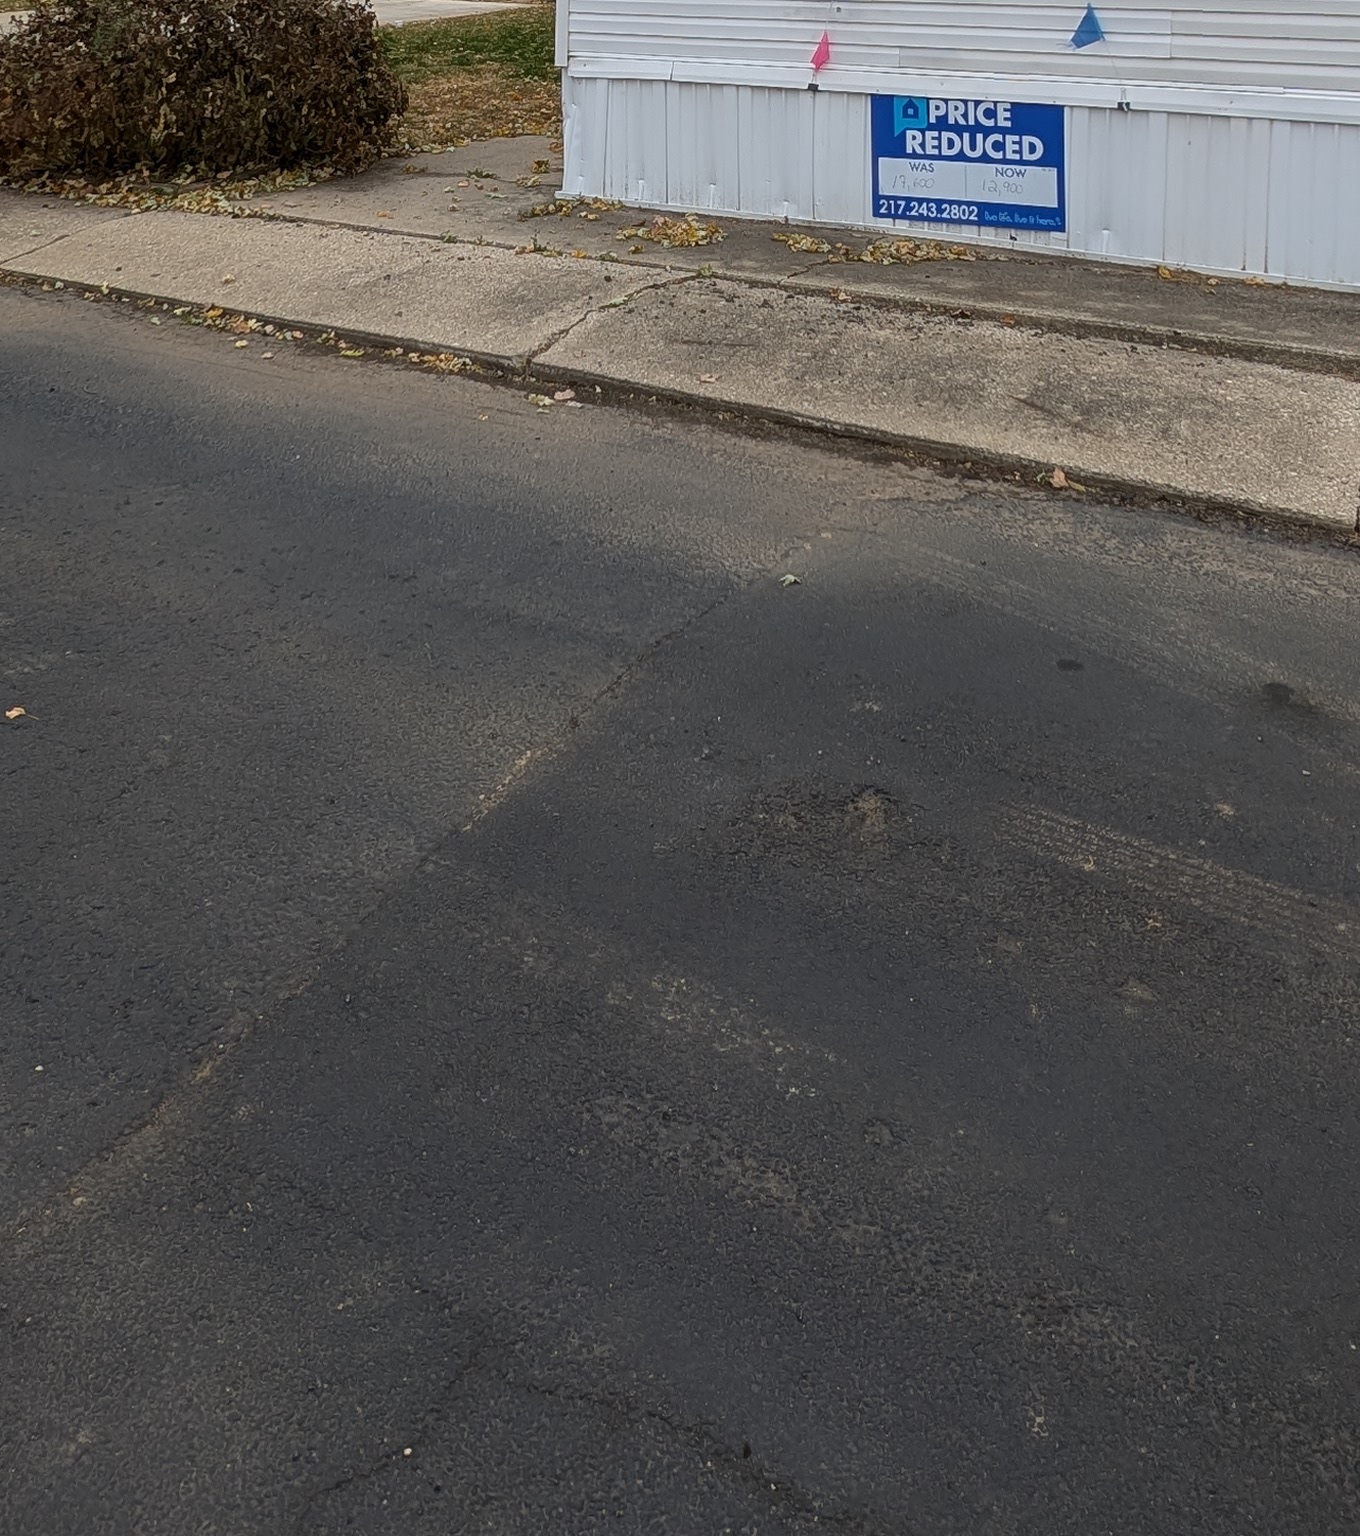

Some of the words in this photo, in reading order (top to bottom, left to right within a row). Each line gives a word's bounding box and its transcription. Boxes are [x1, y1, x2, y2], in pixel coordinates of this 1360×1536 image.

[928, 99, 1013, 128] PRICE
[905, 129, 1045, 161] REDUCED
[908, 161, 935, 173] WAS
[995, 166, 1027, 178] NOW
[982, 178, 1024, 196] 12,900
[878, 199, 979, 221] 217.243.2802
